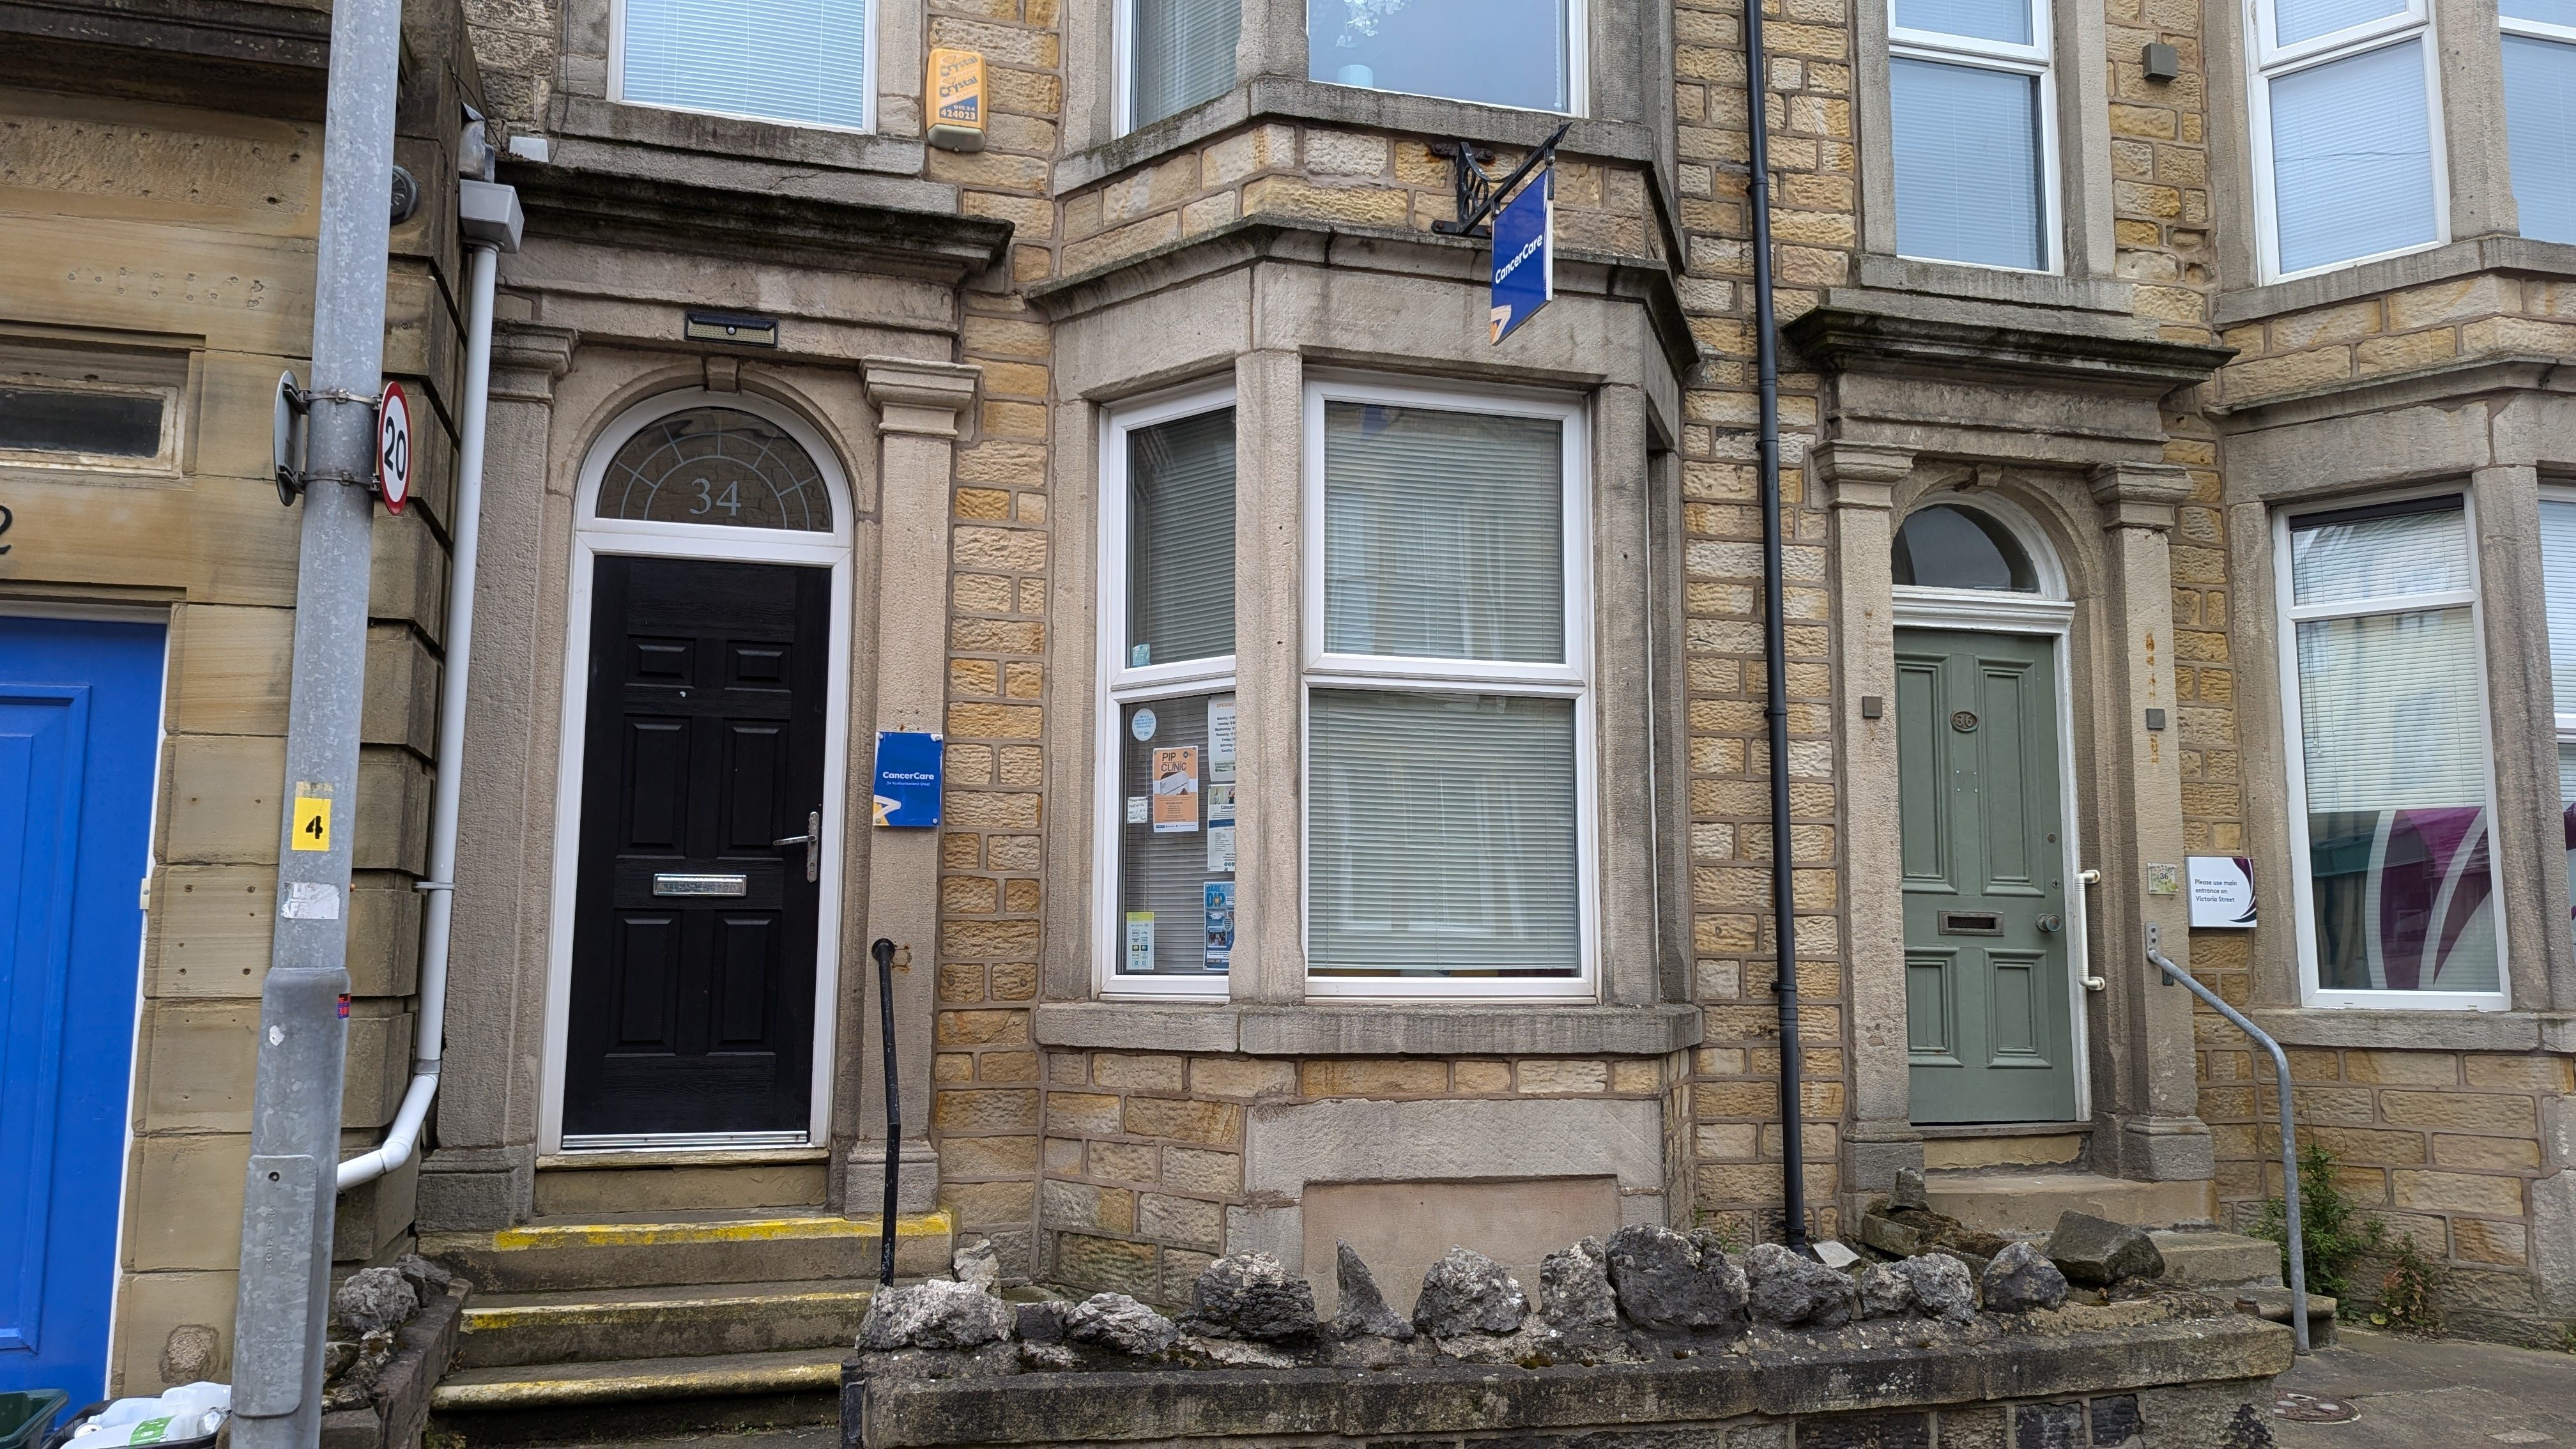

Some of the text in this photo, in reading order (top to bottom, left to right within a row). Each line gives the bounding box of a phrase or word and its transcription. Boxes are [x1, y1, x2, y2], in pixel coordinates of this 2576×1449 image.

[940, 56, 977, 77] Crystal
[940, 77, 978, 97] Crystal
[941, 109, 976, 120] 424023
[1496, 234, 1542, 284] CancerCare
[385, 416, 406, 481] 20
[690, 478, 741, 516] 34
[1955, 714, 1974, 728] 36
[1162, 752, 1176, 761] PIP
[1161, 762, 1187, 771] CLINIC
[882, 771, 935, 780] CancerCare
[305, 815, 323, 839] 4
[1206, 893, 1225, 907] DIP
